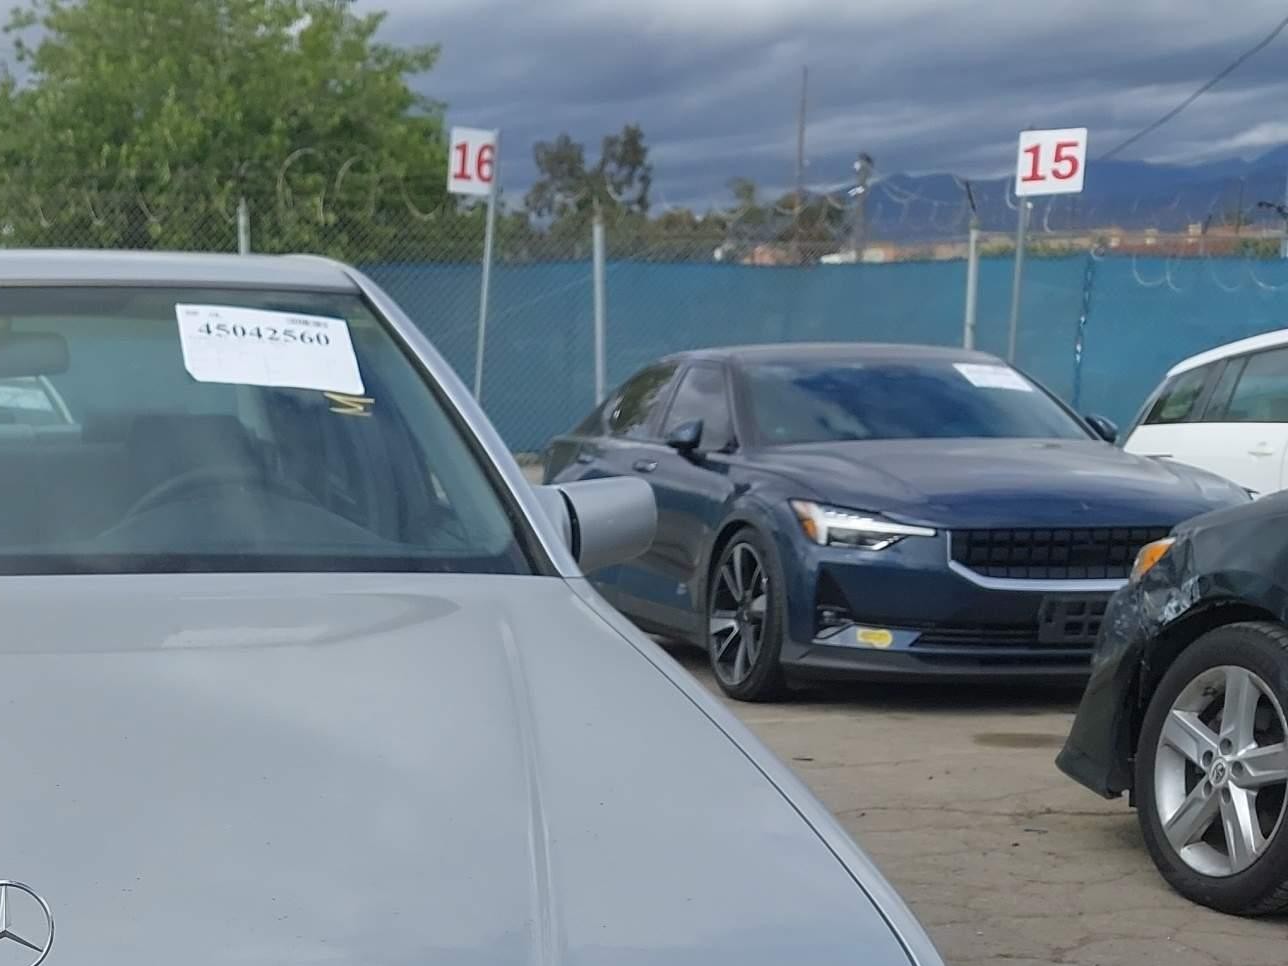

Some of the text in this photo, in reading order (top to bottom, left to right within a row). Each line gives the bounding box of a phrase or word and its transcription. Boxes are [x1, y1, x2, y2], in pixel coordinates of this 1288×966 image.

[454, 143, 495, 182] 16
[1021, 141, 1080, 182] 15
[198, 321, 330, 346] 45042560
